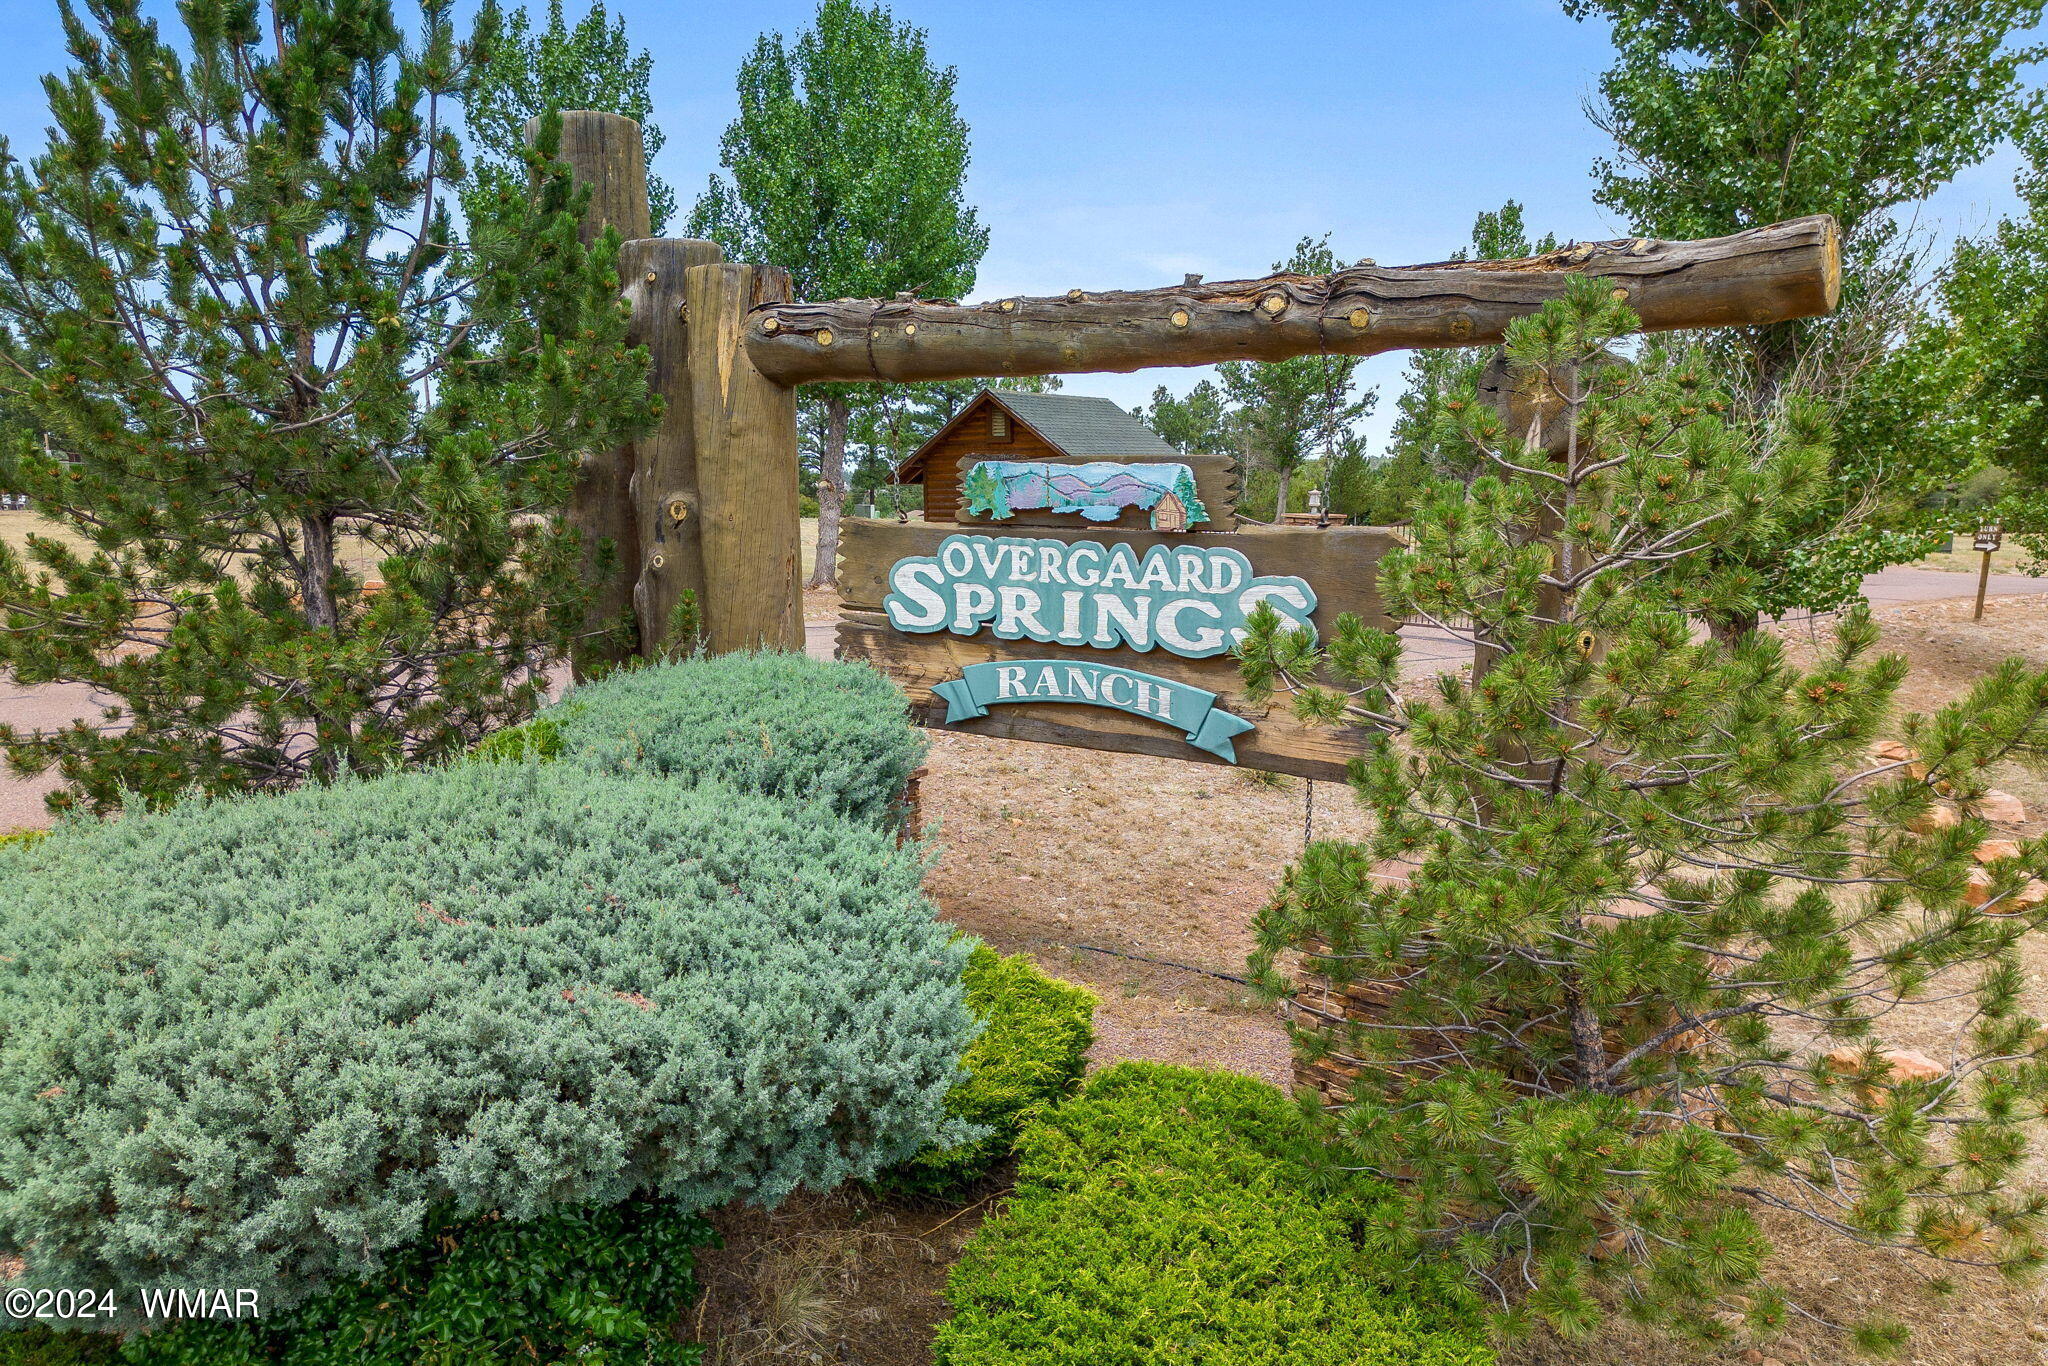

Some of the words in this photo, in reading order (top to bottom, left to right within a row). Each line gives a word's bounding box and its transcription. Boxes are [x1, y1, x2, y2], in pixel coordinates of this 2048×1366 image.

[942, 541, 1242, 595] OVERGAARD
[888, 563, 1309, 654] SPRINGS
[995, 666, 1174, 721] RANCH
